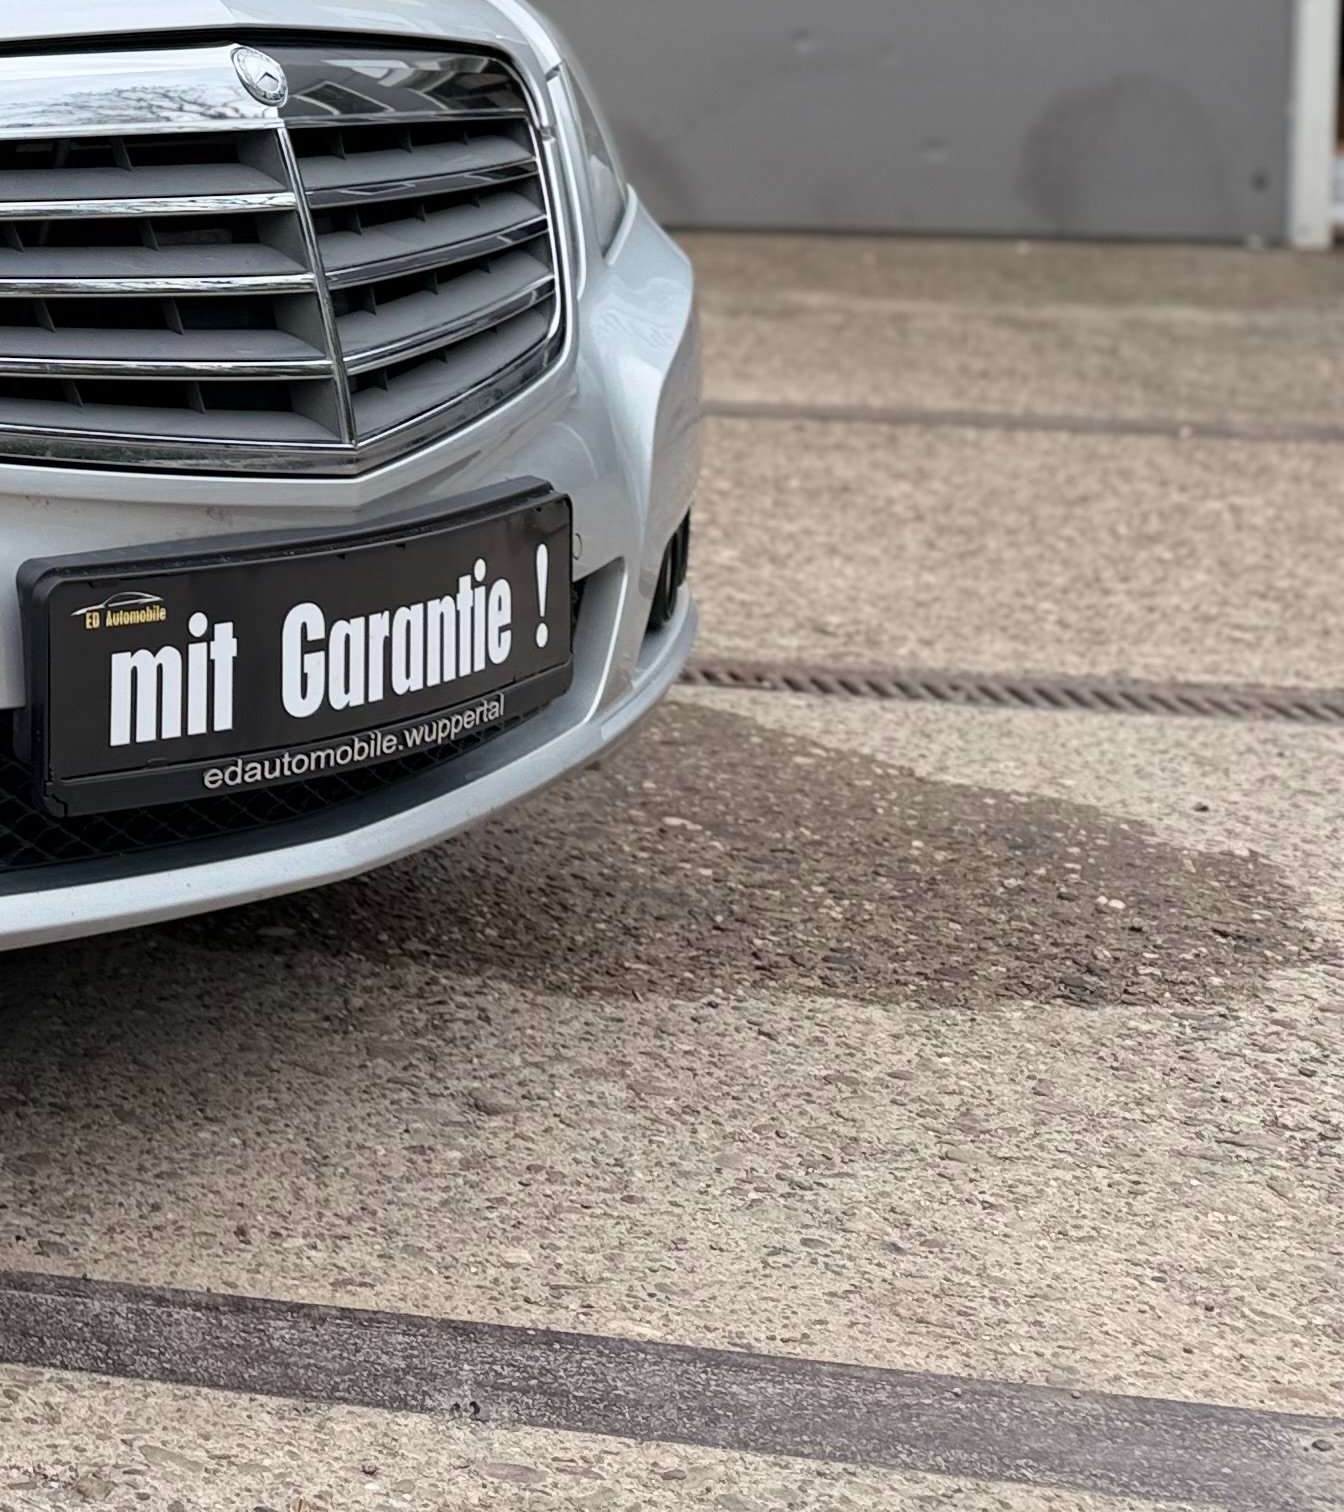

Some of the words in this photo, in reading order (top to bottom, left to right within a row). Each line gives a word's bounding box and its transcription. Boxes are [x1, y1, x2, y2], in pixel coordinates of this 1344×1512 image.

[86, 612, 100, 629] ED
[106, 605, 167, 626] Automobile
[109, 611, 238, 747] mit
[281, 557, 512, 719] Garantie
[535, 543, 549, 649] !
[202, 693, 506, 790] edautomobile.wuppertal
